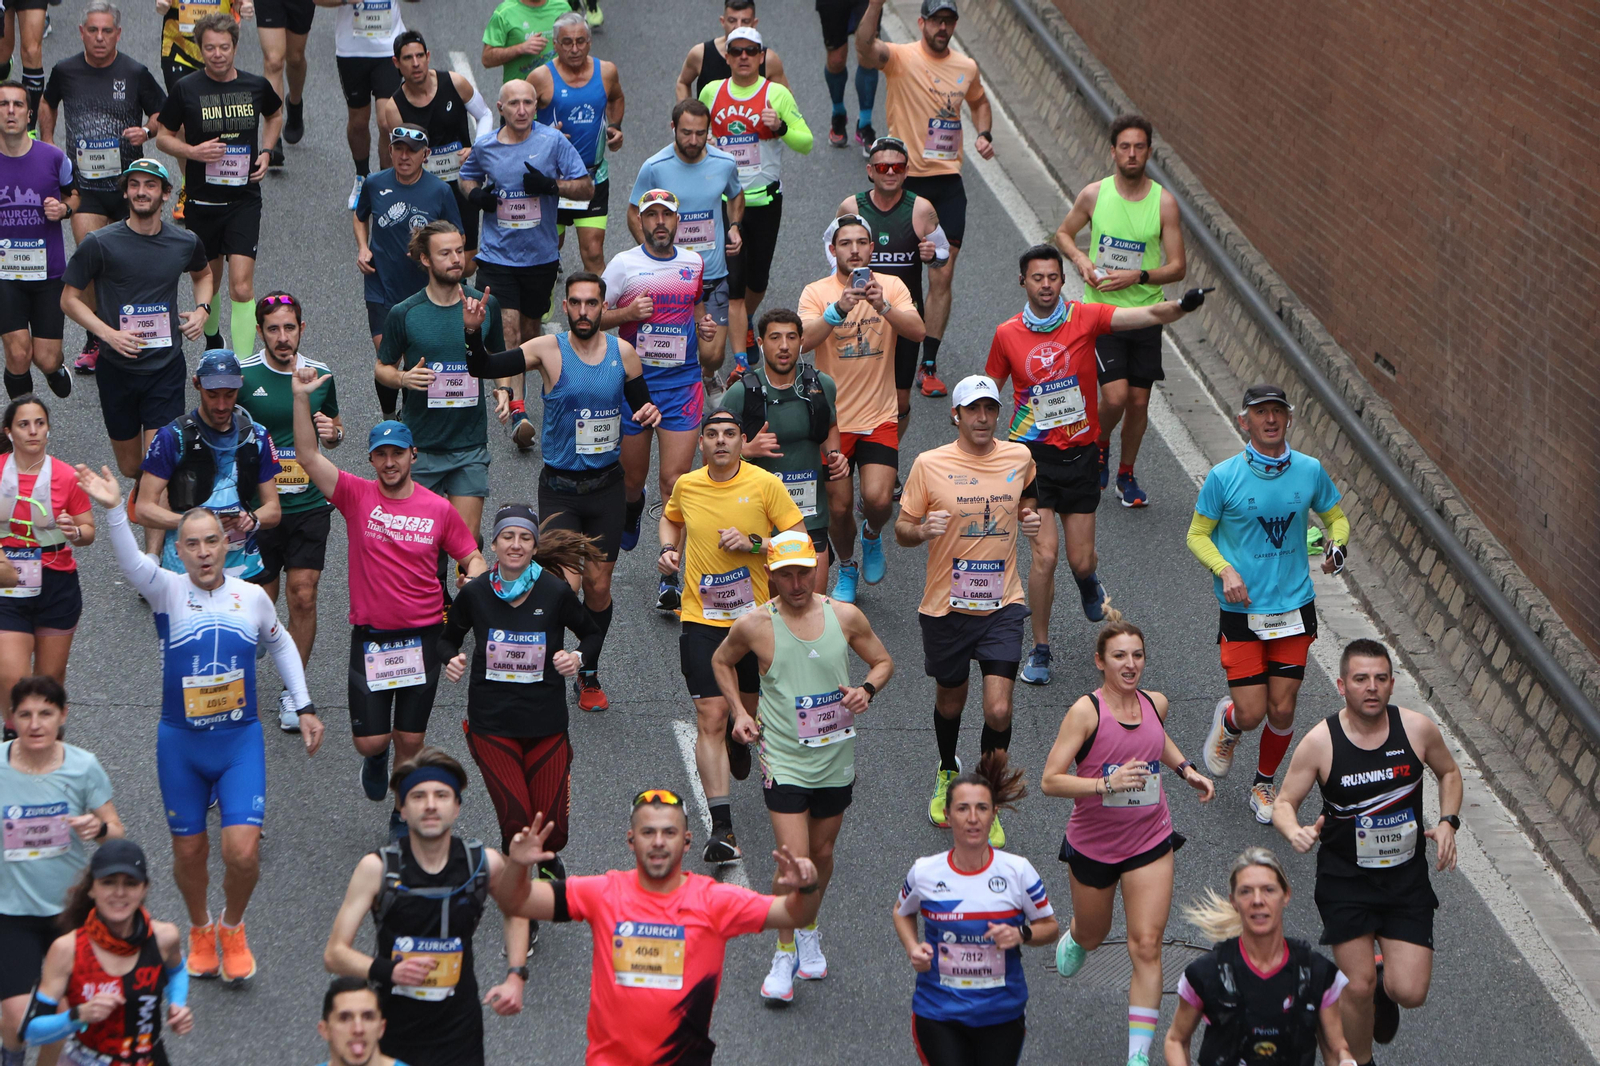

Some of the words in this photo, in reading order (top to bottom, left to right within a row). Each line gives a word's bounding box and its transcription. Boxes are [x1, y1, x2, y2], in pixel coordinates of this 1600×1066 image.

[202, 107, 222, 120] RUN
[224, 104, 254, 118] UTREG
[714, 105, 758, 128] ITALIA
[434, 144, 458, 154] ZURICH
[0, 209, 39, 218] MURCIA
[684, 212, 709, 220] ZURICH
[2, 216, 45, 226] ARATÓN
[1114, 240, 1140, 250] ZURICH
[870, 251, 914, 262] ERRY
[654, 326, 682, 334] ZURICH
[1046, 379, 1073, 391] ZURICH
[1048, 396, 1066, 406] 9882
[594, 408, 620, 416] ZURICH
[594, 424, 610, 432] 8230
[1062, 418, 1089, 437] Team
[786, 472, 812, 480] ZURICH
[788, 488, 804, 496] 0070
[390, 530, 405, 540] Villa
[404, 534, 412, 542] de
[413, 534, 434, 545] Madrid
[714, 570, 744, 584] ZURICH
[970, 578, 988, 586] 7920
[716, 590, 736, 599] 7228
[714, 598, 745, 609] CRISTÓBAL
[508, 634, 538, 642] ZURICH
[506, 650, 526, 659] 7987
[384, 656, 404, 666] 6626
[376, 670, 394, 679] DAVID
[396, 667, 416, 676] OTERO
[206, 697, 228, 708] 5107
[816, 692, 845, 705] ZURICH
[818, 710, 836, 722] 7287
[818, 724, 838, 734] PEDRO
[25, 804, 62, 816] ZURICH
[1377, 813, 1408, 826] ZURICH
[1374, 833, 1401, 844] 10129
[638, 926, 677, 937] ZURICH
[418, 942, 456, 951] ZURICH
[960, 952, 983, 962] 7812
[631, 963, 662, 972] MOUNIR
[952, 968, 992, 976] ELISABETH
